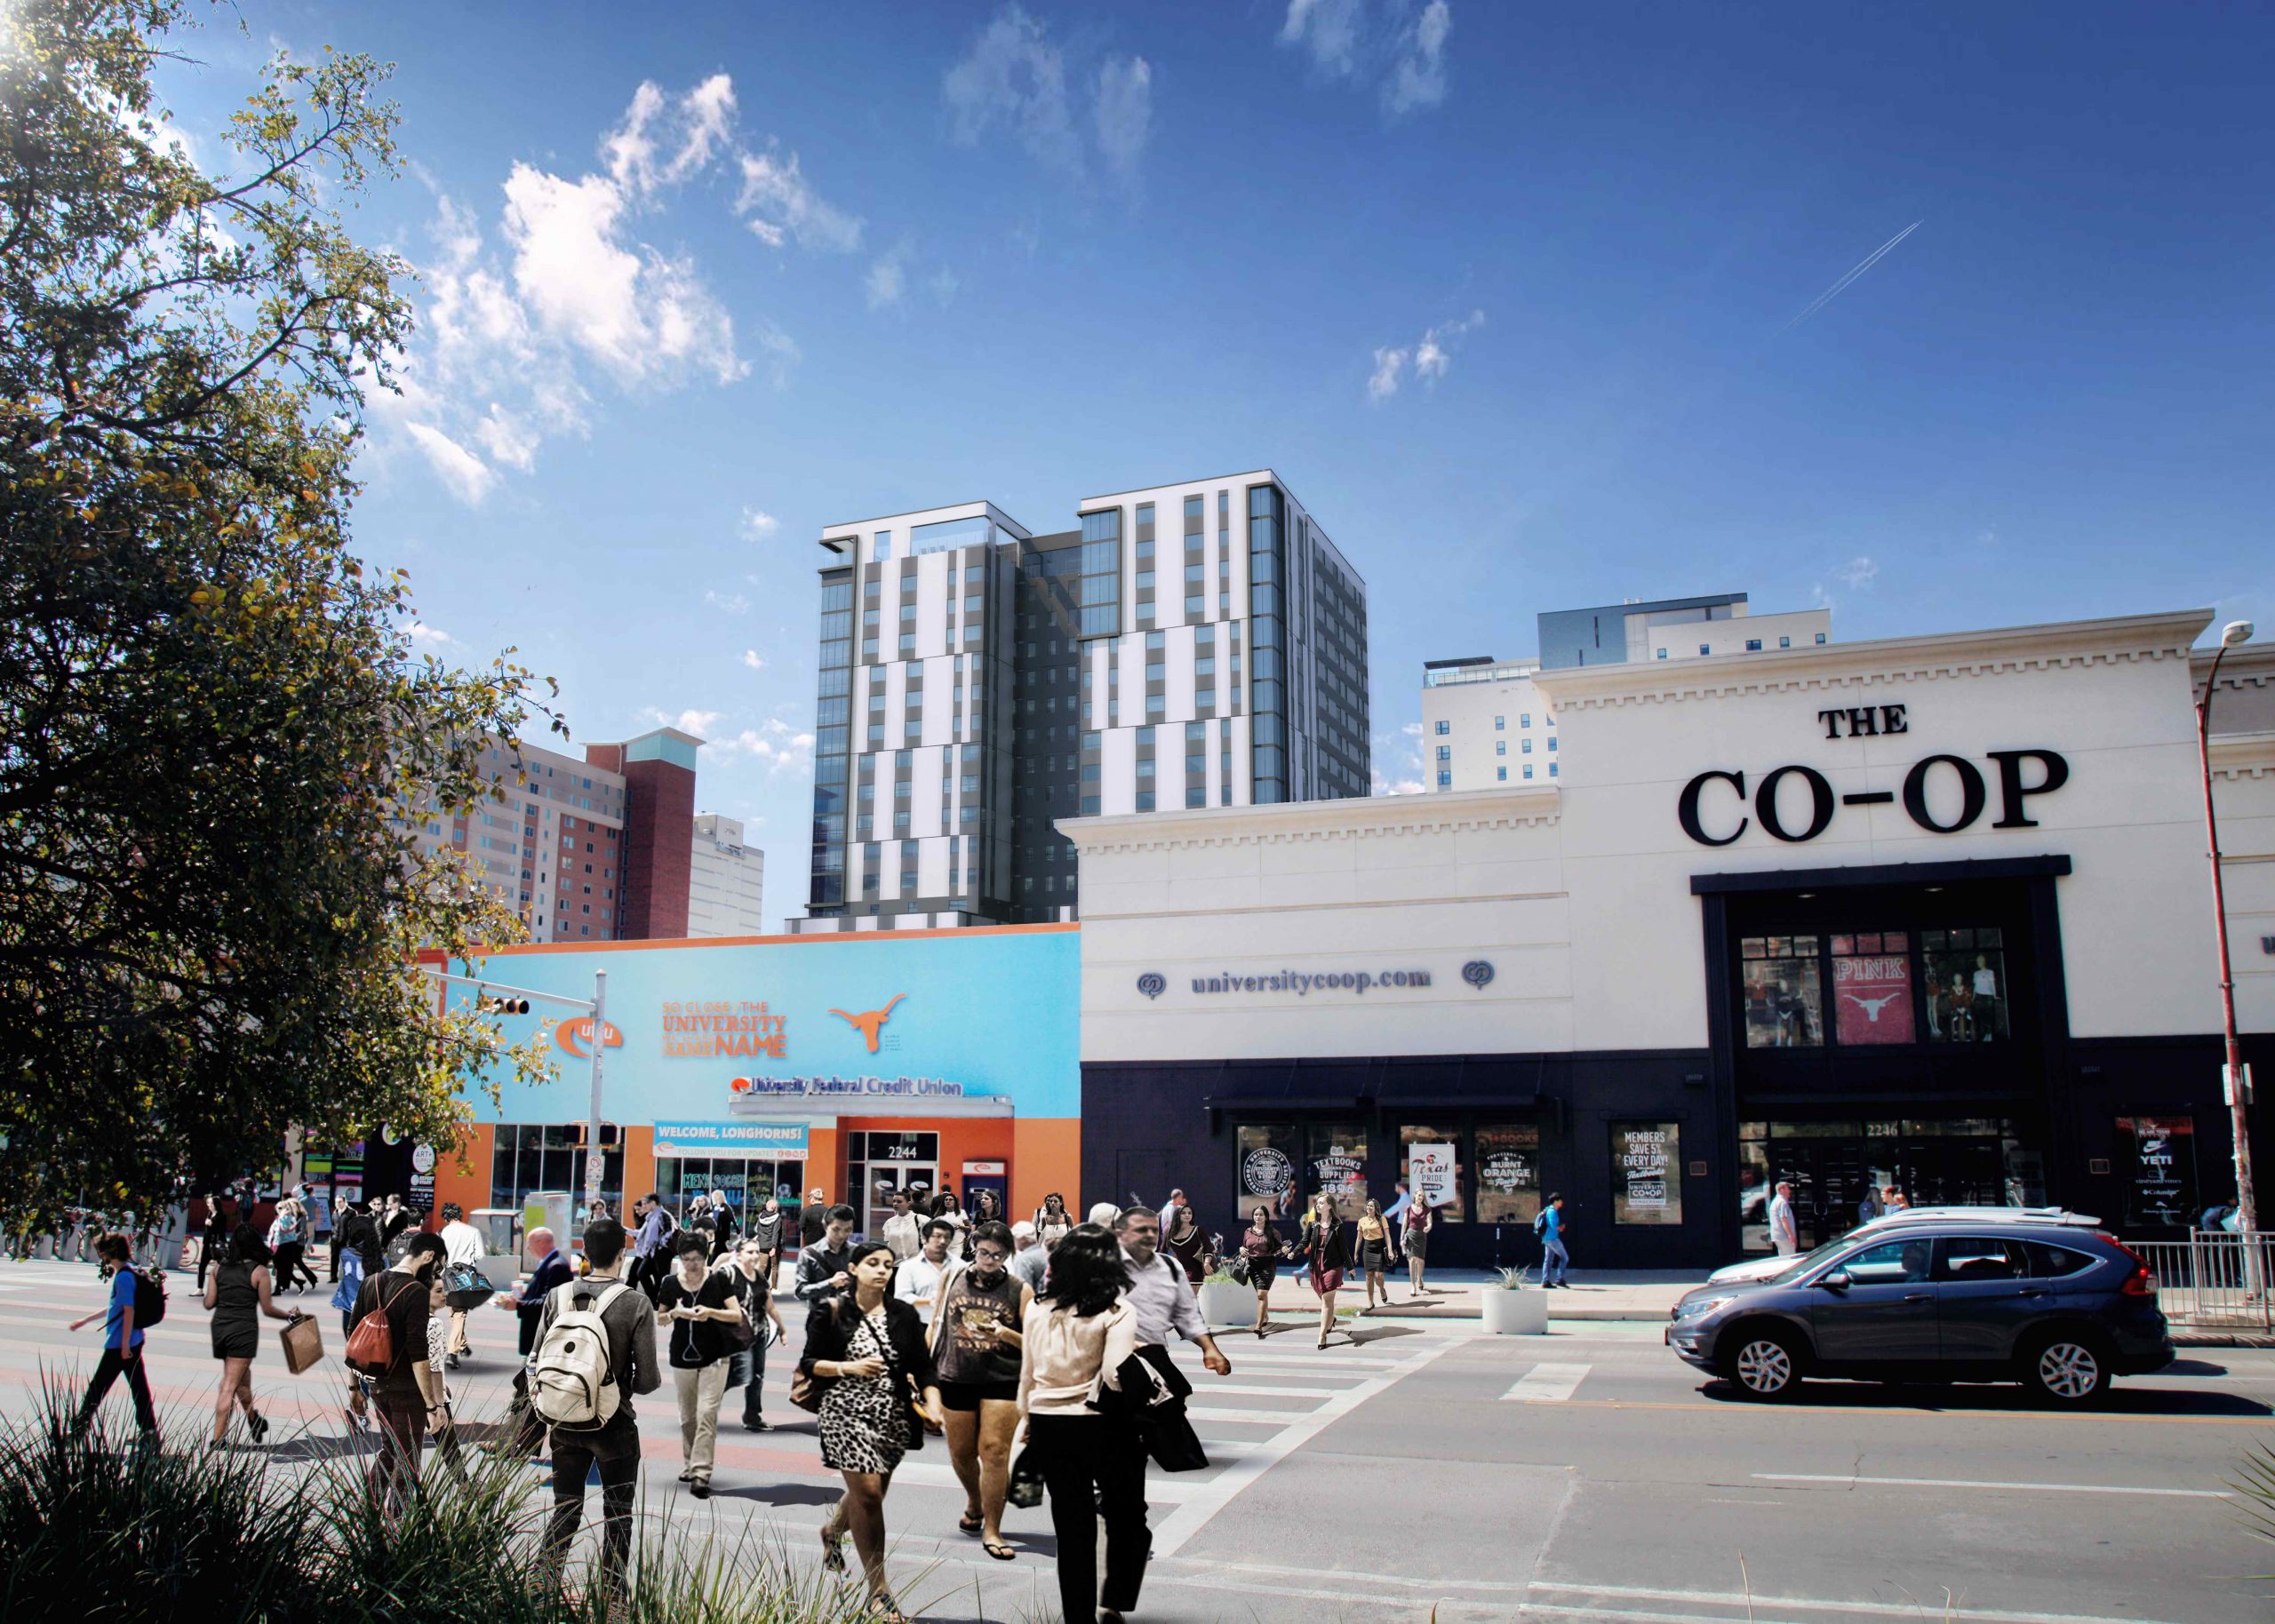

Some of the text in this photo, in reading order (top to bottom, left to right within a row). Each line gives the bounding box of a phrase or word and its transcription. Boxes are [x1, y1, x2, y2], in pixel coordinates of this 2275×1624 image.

[1818, 704, 1908, 739] THE
[1678, 748, 2070, 847] CO-OP
[1834, 958, 1905, 981] PINK
[1192, 969, 1433, 996] universitycoop.com
[662, 1002, 681, 1014] SO
[685, 1001, 730, 1014] CLOSE
[740, 1001, 768, 1013] THE
[662, 1015, 786, 1032] UNIVERSITY
[714, 1034, 786, 1056] NAME
[752, 1077, 962, 1098] University Federal Credit Union
[659, 1126, 803, 1140] WELCOME, LONGHORNS!
[1624, 1131, 1665, 1143] MEMBERS
[1867, 1123, 1898, 1137] 2246
[889, 1146, 917, 1158] 2244
[1630, 1143, 1662, 1154] SAVE 5%
[1249, 1150, 1285, 1162] UNIVERSITY
[1624, 1155, 1669, 1166] EVERY DAY!
[2140, 1156, 2173, 1165] YETI
[1313, 1157, 1361, 1170] TEXTBOOKS
[1411, 1158, 1449, 1174] Texas
[1246, 1164, 1273, 1194] COOPERATIVE
[1483, 1168, 1531, 1177] ORANGE
[1321, 1183, 1354, 1194] 1896
